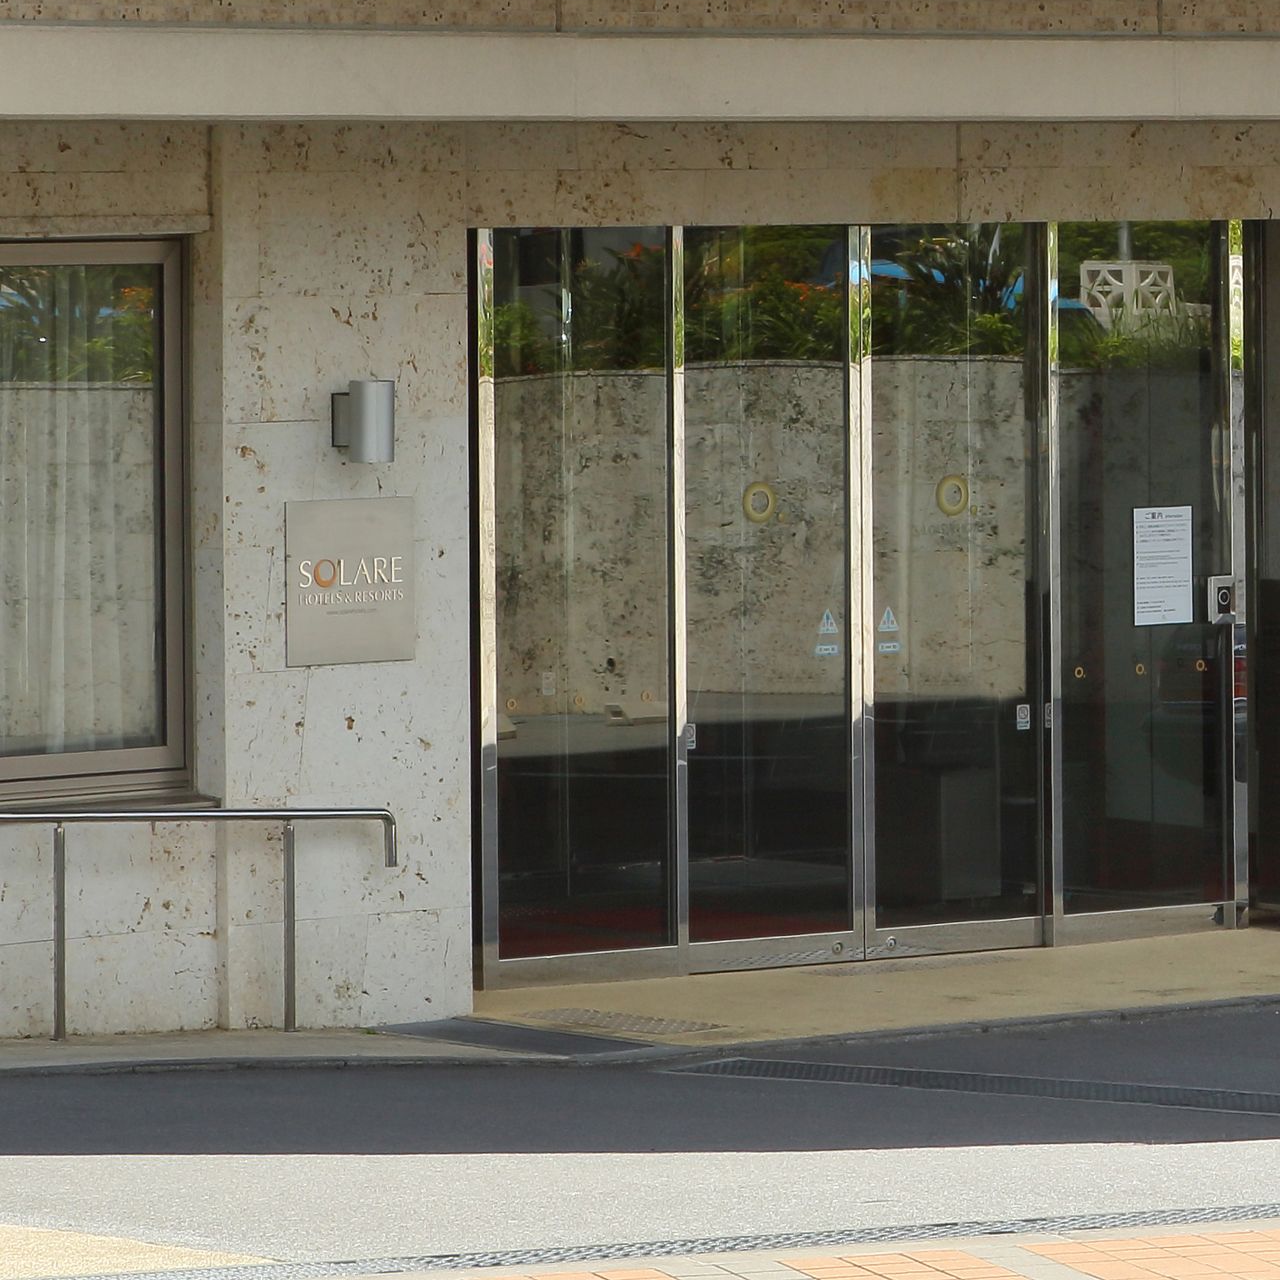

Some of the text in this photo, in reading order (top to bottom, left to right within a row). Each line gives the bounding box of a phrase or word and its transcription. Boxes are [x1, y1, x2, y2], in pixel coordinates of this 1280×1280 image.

[299, 556, 403, 588] SOLARE
[299, 589, 404, 606] HOTELS & RESORTS
